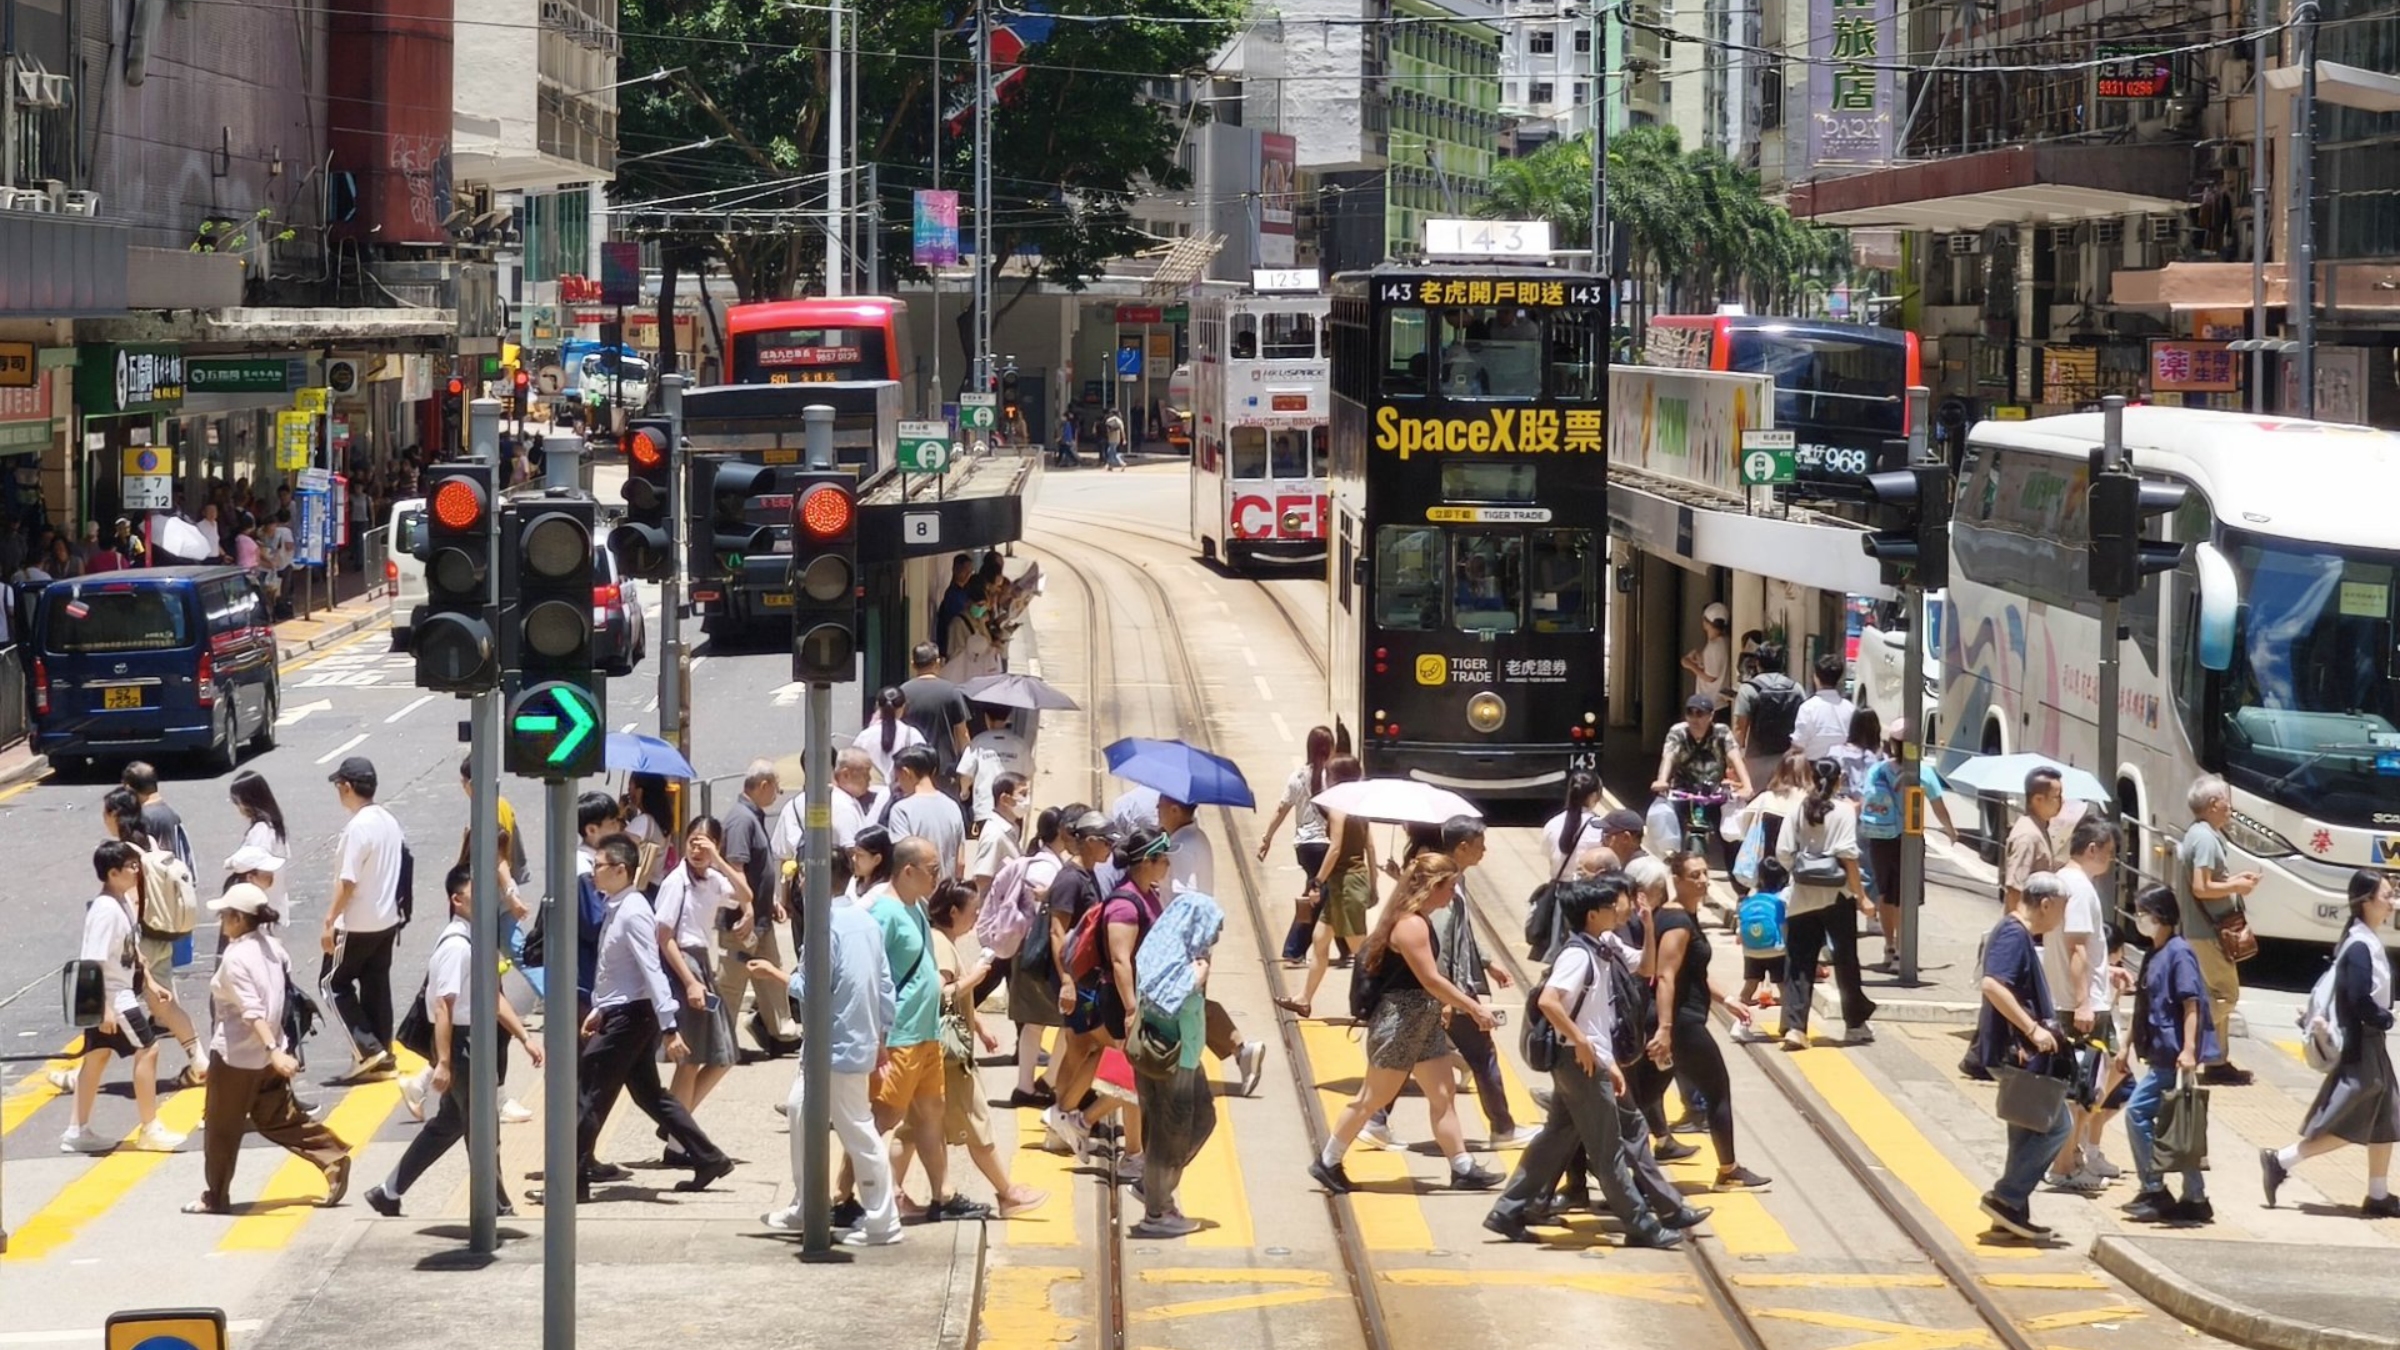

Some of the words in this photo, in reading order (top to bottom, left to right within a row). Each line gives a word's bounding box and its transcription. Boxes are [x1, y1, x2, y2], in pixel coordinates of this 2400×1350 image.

[1831, 0, 1877, 112] 旅店
[1458, 225, 1523, 251] 143
[1270, 273, 1301, 287] 125
[1381, 283, 1412, 301] 143
[1419, 280, 1564, 306] 老虎開戶即送
[1571, 286, 1601, 304] 143
[1375, 406, 1602, 460] SpaceX股票
[1825, 447, 1866, 474] 968
[153, 477, 162, 489] 7
[154, 495, 169, 507] 12
[1484, 511, 1511, 520] TIGER
[1513, 511, 1545, 520] TRADE
[916, 521, 927, 536] 8
[1451, 657, 1488, 670] TIGER
[1451, 671, 1492, 683] TRADE
[1569, 752, 1596, 770] 143
[2317, 904, 2339, 919] UR
